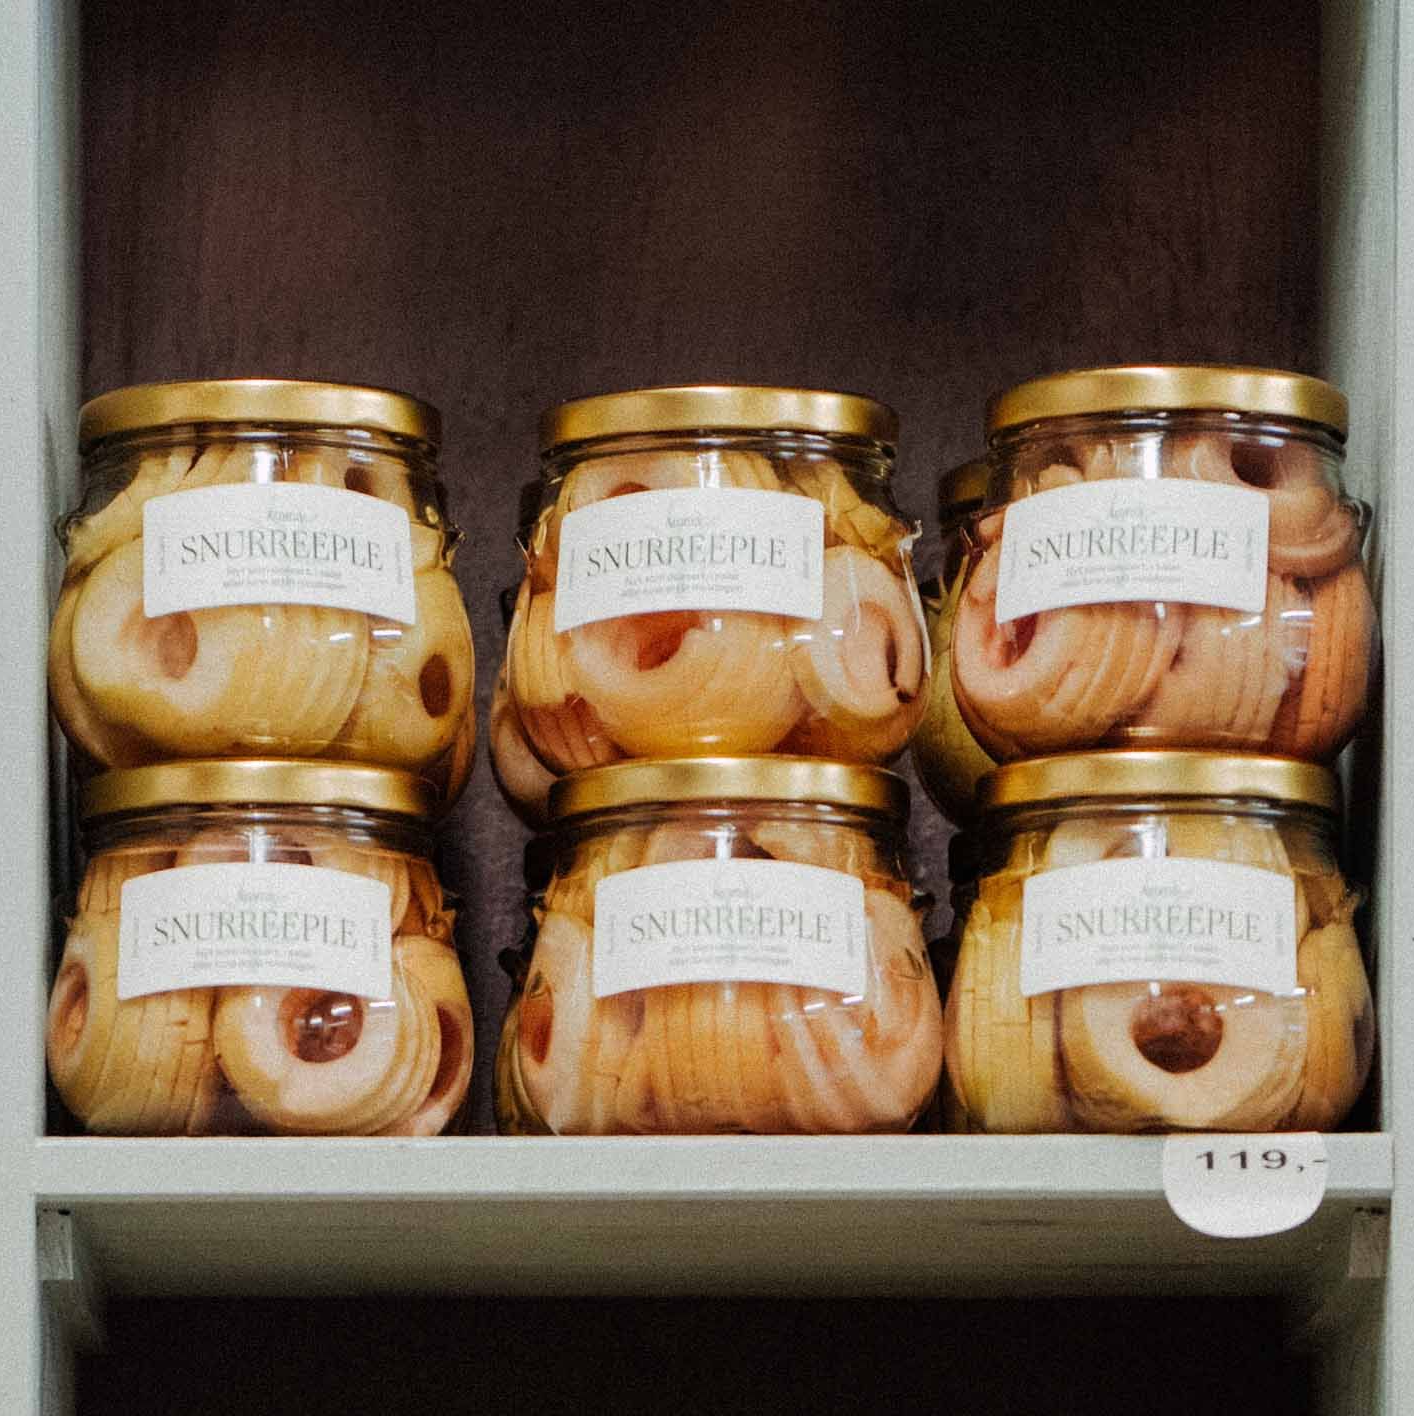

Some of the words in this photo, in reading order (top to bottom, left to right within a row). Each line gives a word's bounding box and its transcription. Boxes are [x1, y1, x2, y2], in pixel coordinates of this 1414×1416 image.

[180, 529, 384, 571] SNURREEPLE
[586, 534, 786, 577] SNURREEPLE
[1027, 525, 1230, 568] SNURREEPLE
[153, 910, 356, 949] SNURREEPLE
[629, 904, 832, 944] SNURREEPLE
[1056, 902, 1263, 943] SNURREEPLE
[1196, 1150, 1327, 1172] 119,-
